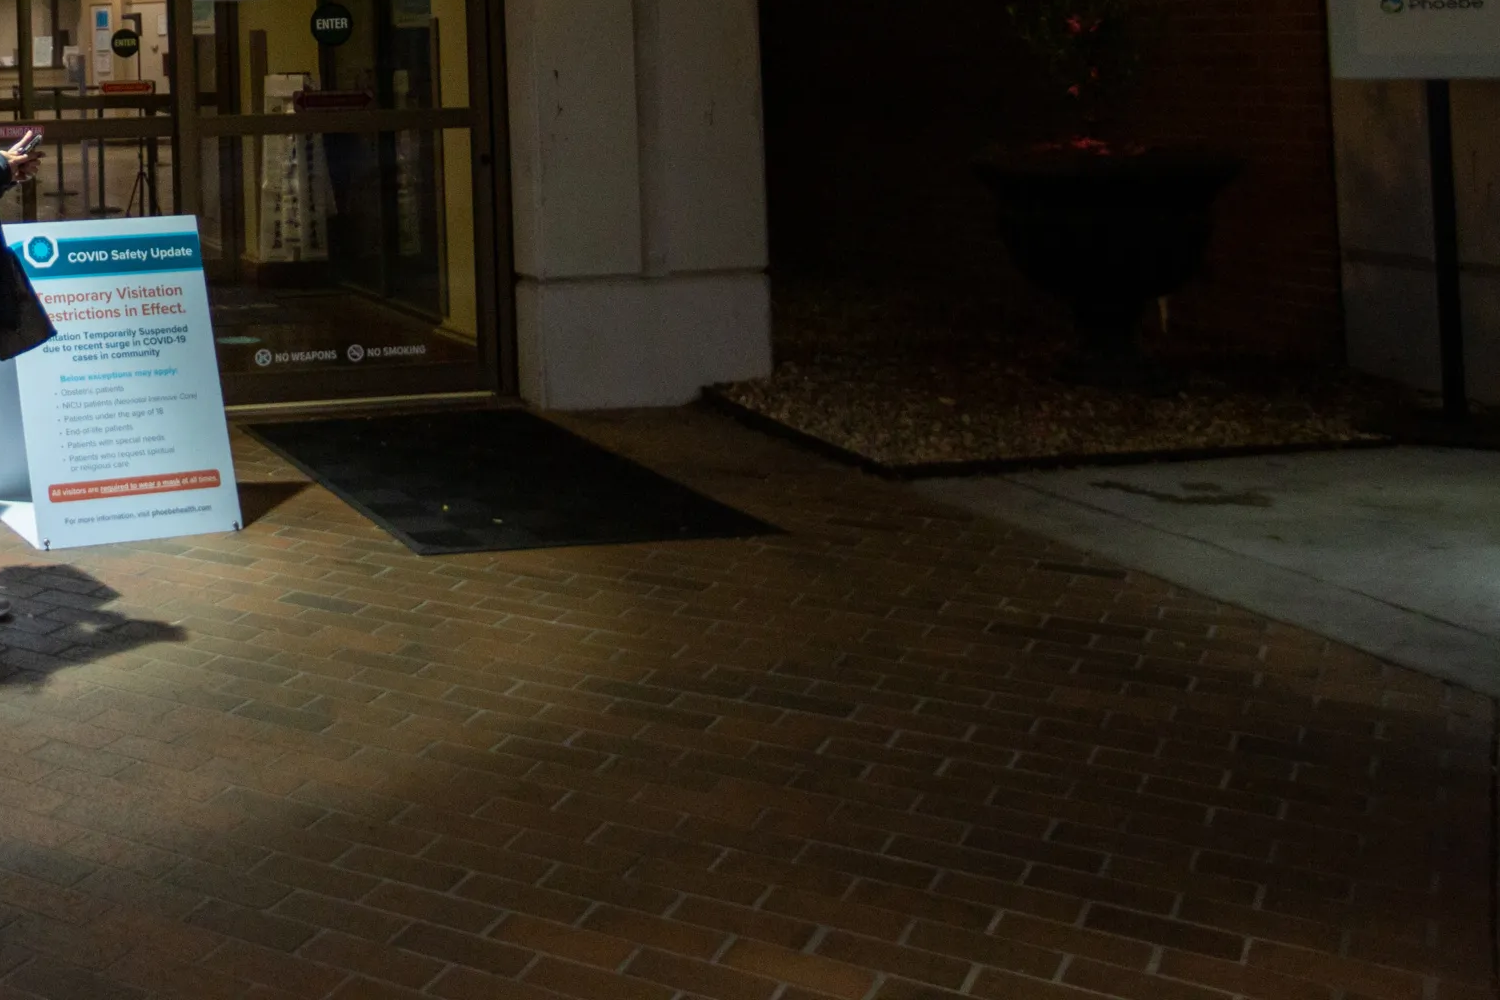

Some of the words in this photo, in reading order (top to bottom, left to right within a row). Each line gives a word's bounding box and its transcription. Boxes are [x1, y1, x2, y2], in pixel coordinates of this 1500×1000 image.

[315, 17, 348, 30] ENTER
[114, 38, 136, 47] ENTER
[67, 250, 108, 263] COVID
[111, 248, 148, 262] Safety
[150, 246, 192, 259] Update
[36, 288, 112, 305] Temporary
[116, 285, 183, 300] Visitation
[48, 306, 121, 322] estrictions
[125, 304, 138, 317] in
[142, 302, 186, 316] Effect.
[83, 328, 137, 341] Temporarily
[139, 324, 188, 339] Suspended
[42, 344, 60, 354] due
[62, 343, 72, 352] to
[74, 341, 103, 351] recent
[104, 339, 130, 351] surge
[133, 337, 141, 347] in
[143, 335, 187, 347] COVID-19
[72, 352, 98, 362] cases
[100, 350, 109, 360] in
[111, 347, 160, 360] community
[275, 351, 289, 362] NO
[291, 350, 338, 362] WEAPONS
[367, 347, 381, 358] NO
[383, 344, 427, 356] SMOKING
[60, 374, 85, 383] Below
[135, 369, 151, 379] may
[96, 385, 125, 396] patients
[62, 401, 81, 410] NICU
[84, 399, 113, 410] patients
[64, 413, 94, 423] Patients
[95, 411, 116, 421] under
[118, 409, 130, 418] the
[131, 409, 145, 419] age
[147, 407, 155, 416] of
[105, 423, 134, 434] patients
[67, 439, 97, 449] Patients
[98, 437, 114, 446] with
[115, 435, 141, 446] special
[142, 434, 166, 442] needs
[69, 452, 98, 462] Patients
[100, 450, 116, 459] who
[117, 448, 146, 460] request
[113, 460, 130, 468] care
[52, 488, 61, 497] All
[63, 486, 87, 496] visitors
[88, 486, 100, 494] are
[101, 482, 129, 494] required
[130, 481, 138, 490] to
[138, 481, 156, 489] wear
[162, 477, 181, 487] mask
[182, 477, 189, 485] at
[64, 517, 76, 526] For
[78, 516, 95, 524] more
[137, 509, 151, 519] visit
